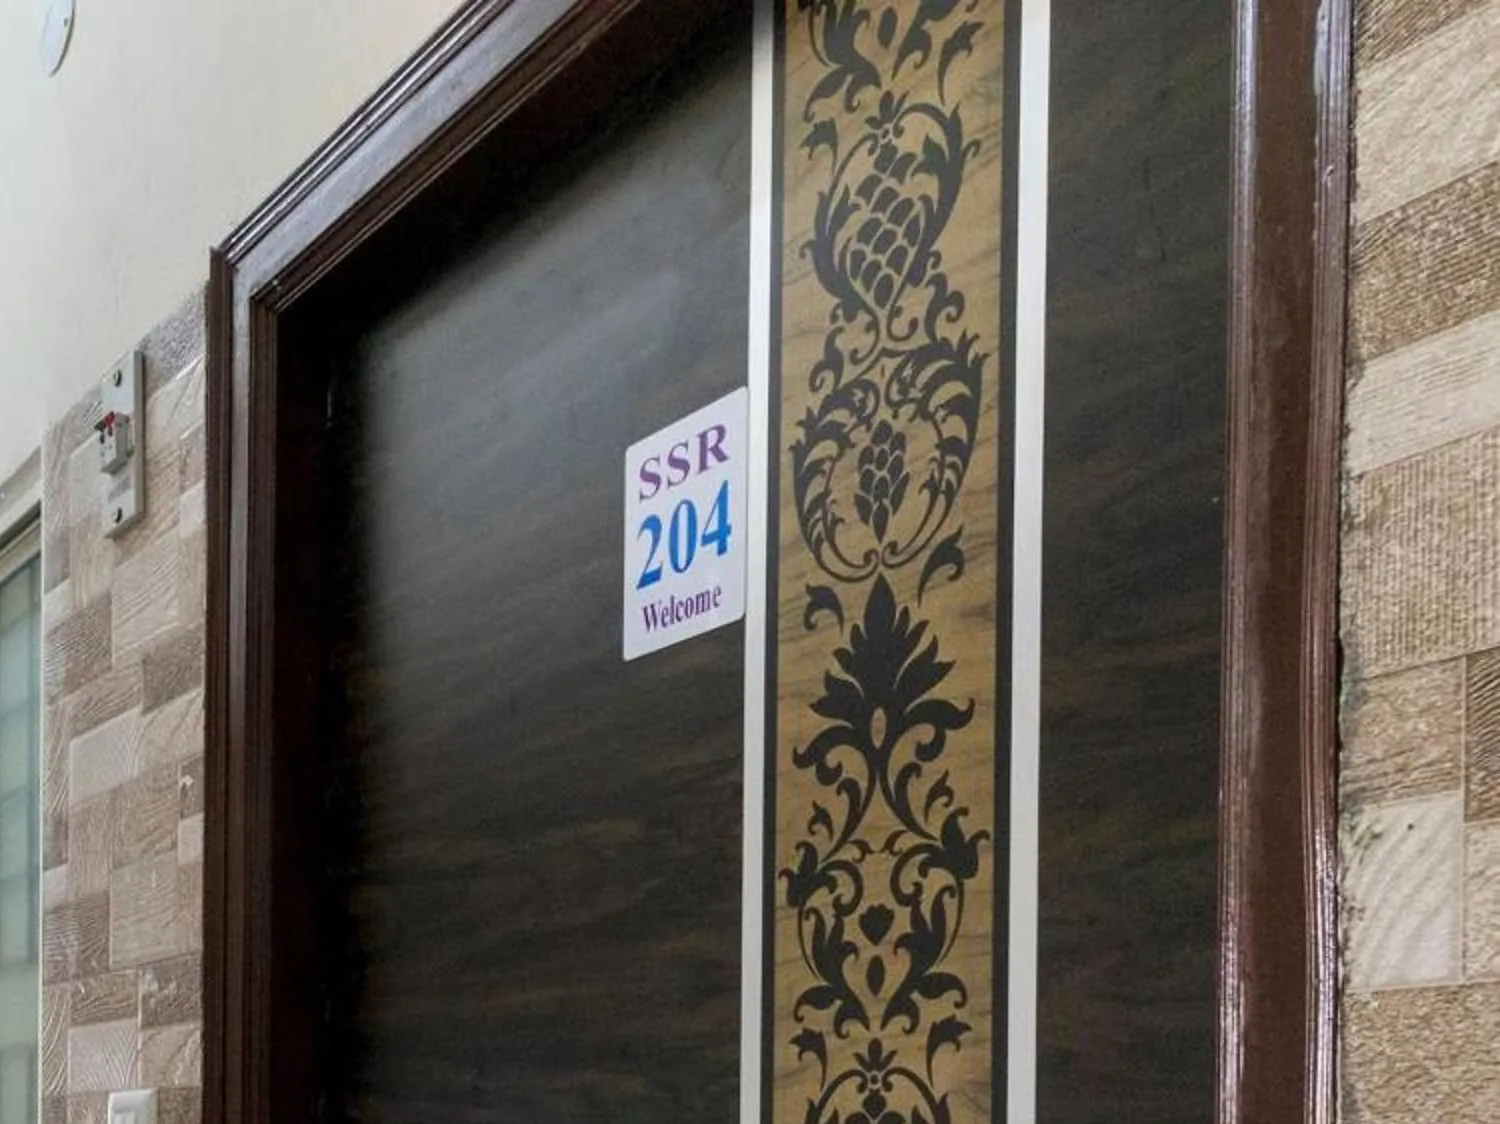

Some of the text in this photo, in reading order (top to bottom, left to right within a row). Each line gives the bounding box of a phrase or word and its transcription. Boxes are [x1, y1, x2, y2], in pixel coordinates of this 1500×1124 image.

[639, 423, 731, 502] SSR
[636, 479, 732, 590] 204
[641, 586, 722, 633] Welcome
